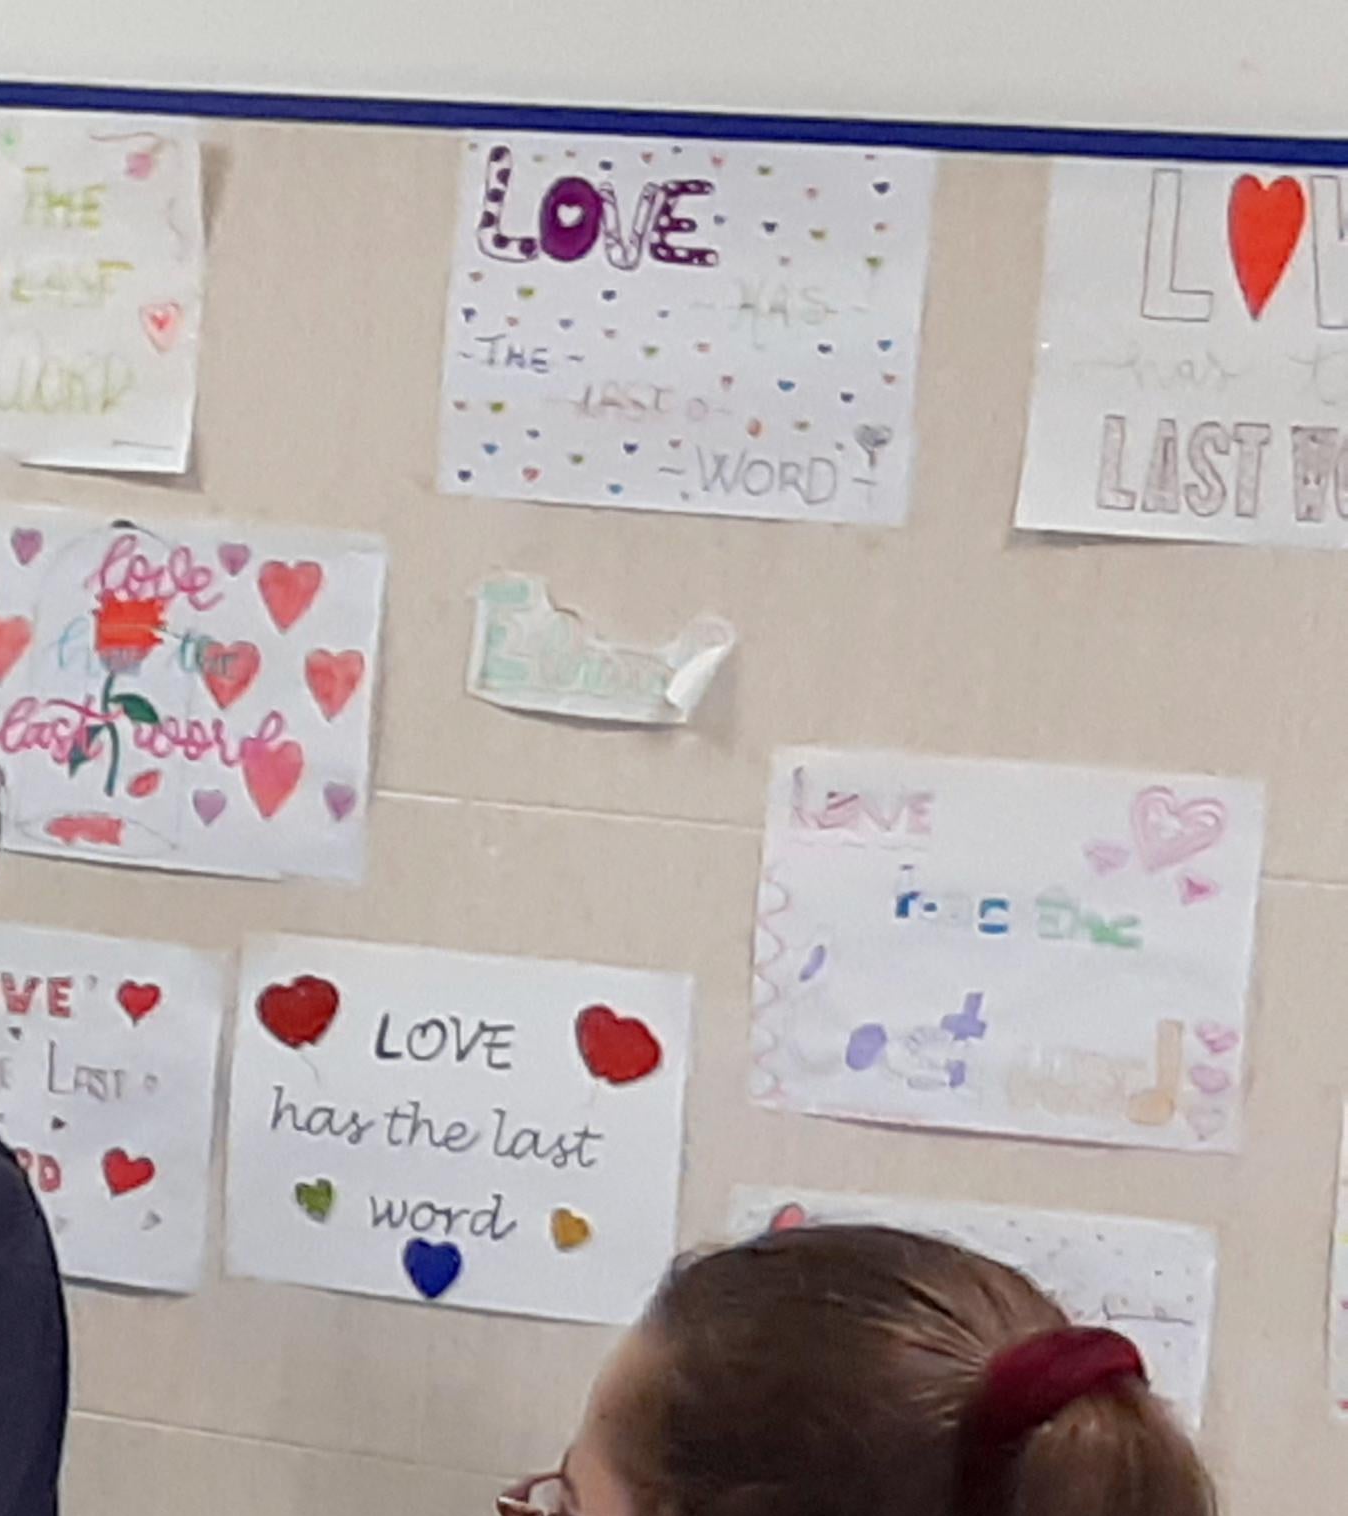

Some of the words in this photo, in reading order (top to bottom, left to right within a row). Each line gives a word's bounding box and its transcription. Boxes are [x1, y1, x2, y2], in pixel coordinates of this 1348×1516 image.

[477, 145, 720, 271] LOVE
[1096, 413, 1273, 518] LAST
[373, 1012, 517, 1070] LOVE
[269, 1085, 377, 1146] has
[384, 1101, 484, 1153] the
[492, 1109, 604, 1169] last
[369, 1194, 518, 1241] word
